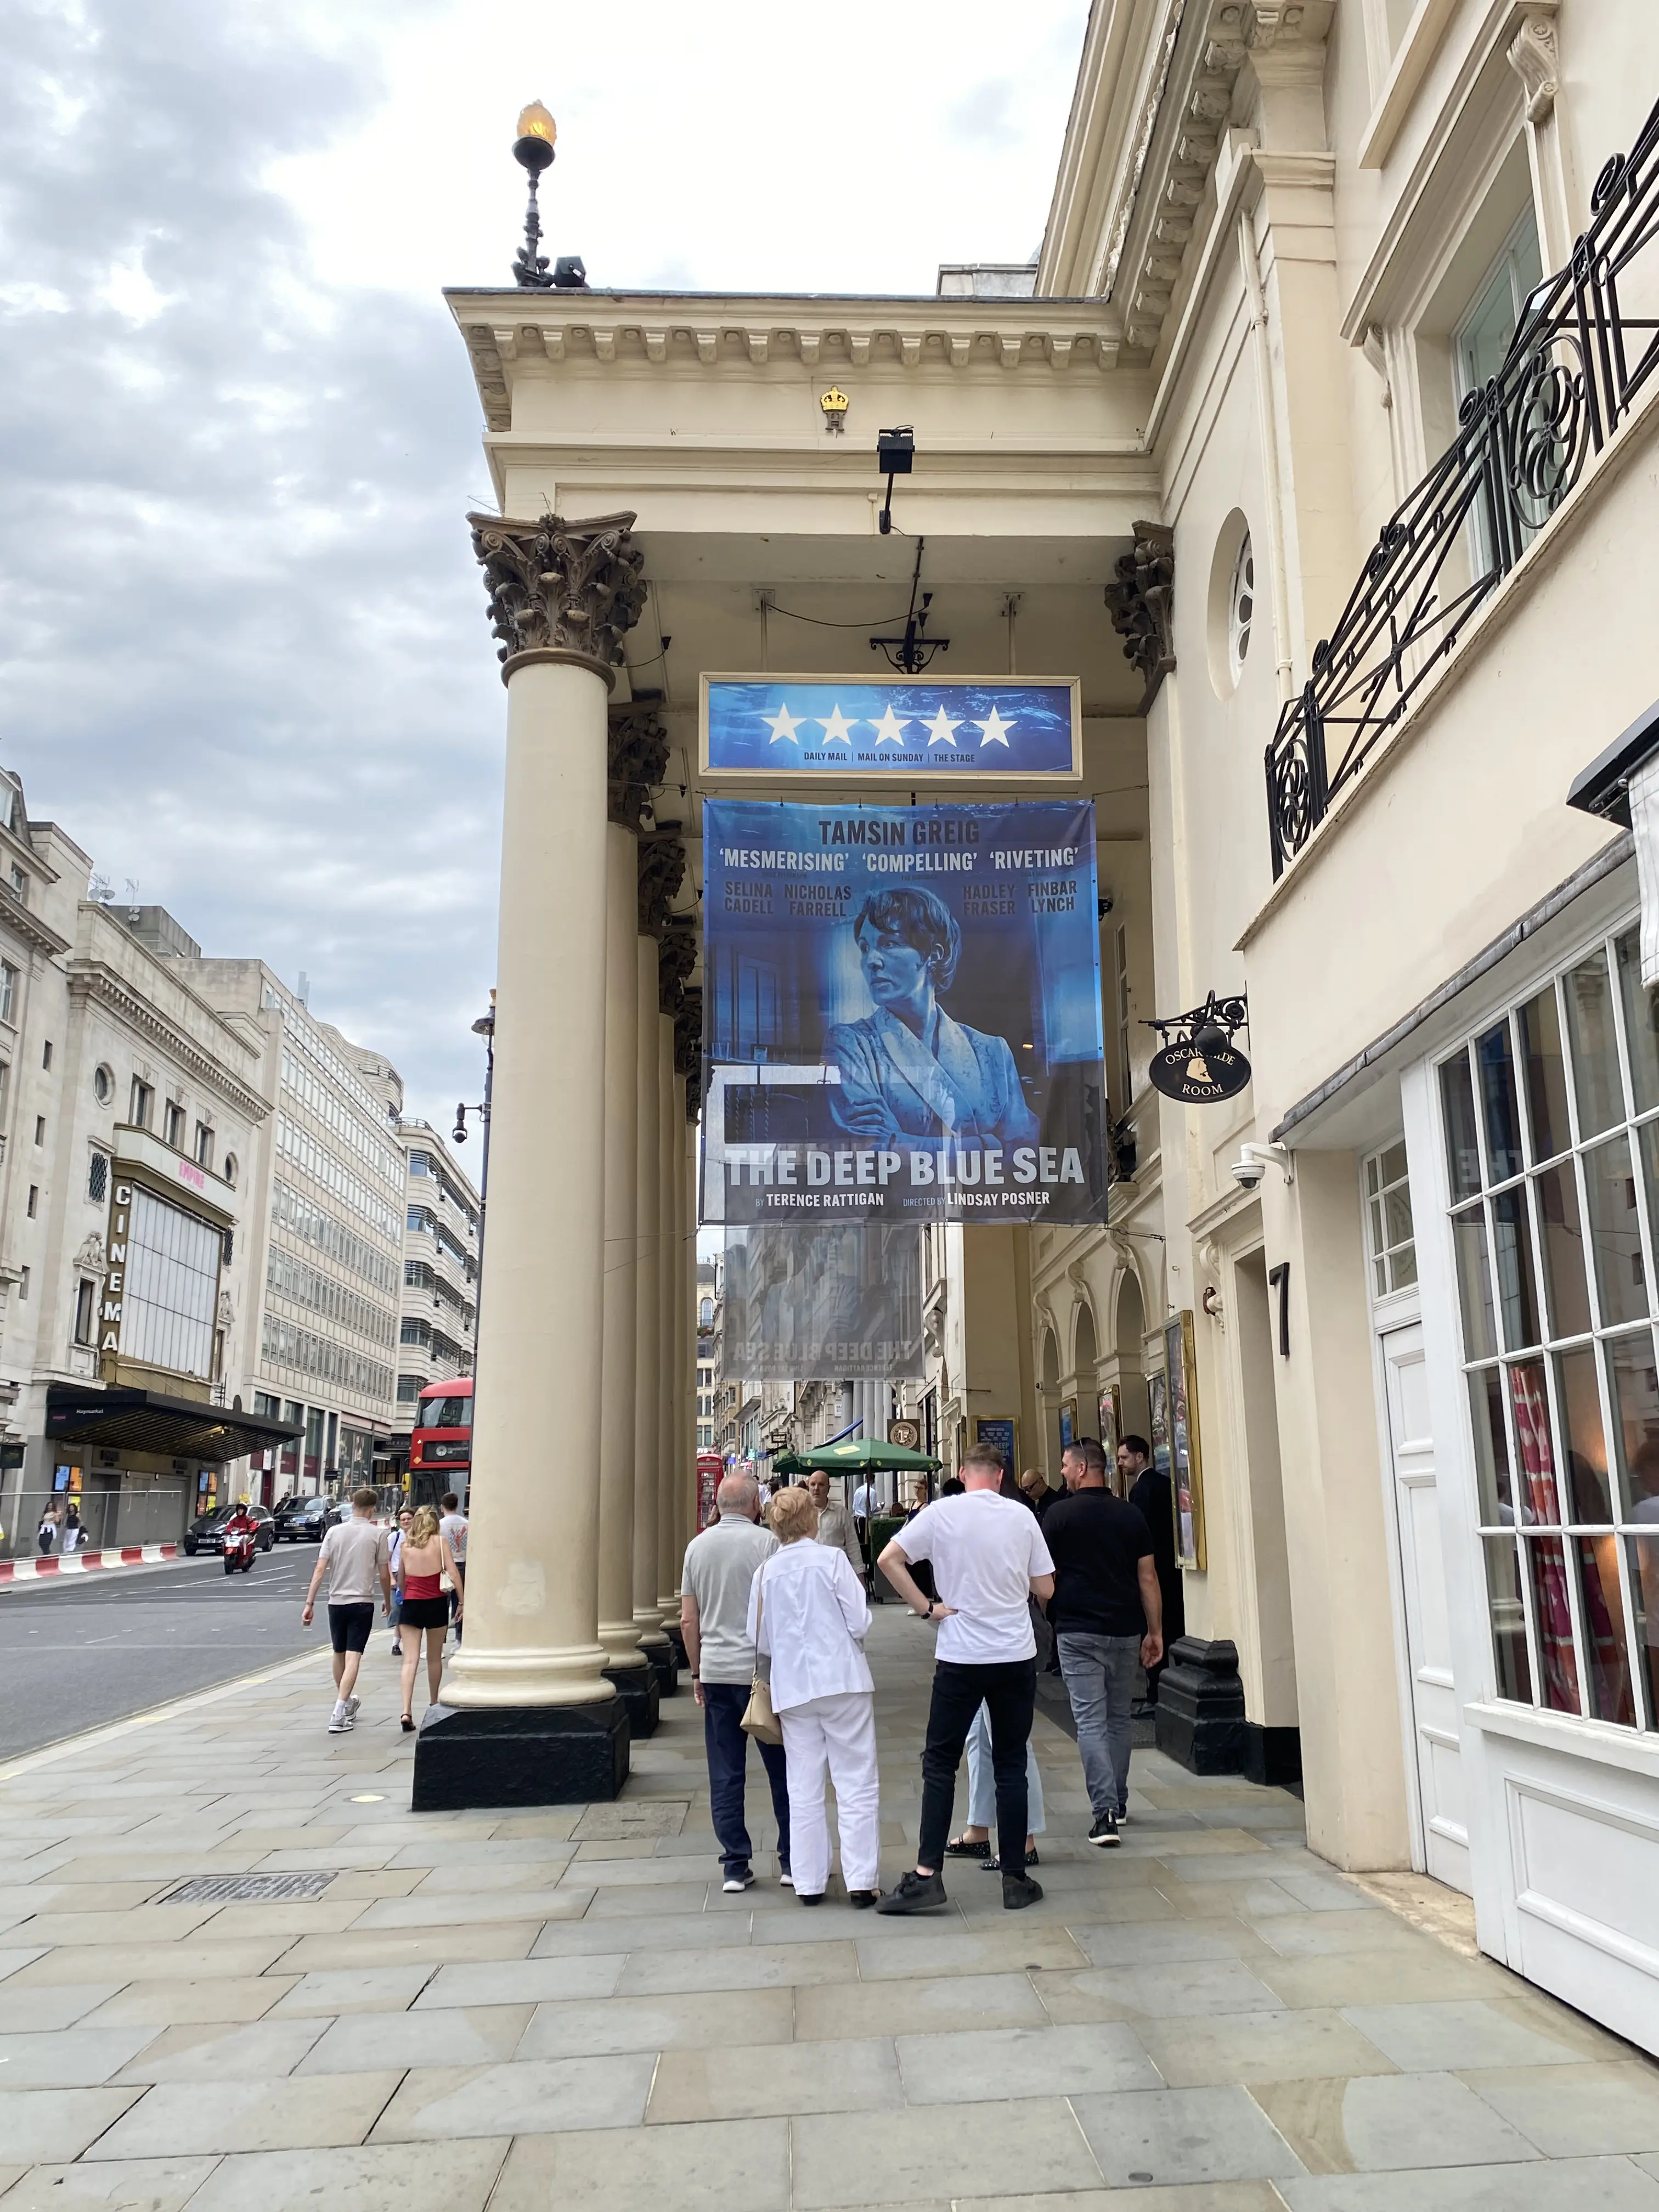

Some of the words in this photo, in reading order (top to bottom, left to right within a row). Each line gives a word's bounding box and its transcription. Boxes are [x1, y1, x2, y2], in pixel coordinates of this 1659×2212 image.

[804, 752, 826, 760] DAILY
[828, 752, 848, 761] MAIL
[857, 753, 877, 761] MAIL
[879, 753, 890, 761] ON
[892, 753, 923, 762] SUNDAY
[934, 754, 949, 762] THE
[950, 754, 975, 763] STAGE
[818, 820, 905, 846] TAMSIN
[912, 819, 979, 845] GREIG
[725, 881, 772, 898] SELINA
[784, 883, 851, 901] NICHOLAS
[963, 884, 1015, 900] HADLEY
[1028, 879, 1077, 898] FINBAR
[724, 897, 774, 915] CADELL
[789, 901, 847, 917] FARRELL
[963, 900, 1015, 916] FRASER
[1031, 896, 1074, 913] LYNCH
[1181, 1084, 1224, 1096] ROOM
[178, 1160, 205, 1189] EMPIRE
[725, 1149, 797, 1186] THE
[806, 1150, 901, 1186] DEEP
[910, 1149, 1005, 1186] BLUE
[1013, 1147, 1085, 1184] SEA
[755, 1198, 764, 1207] BY
[766, 1194, 820, 1207] TERENCE
[823, 1193, 884, 1207] RATTIGAN
[903, 1197, 935, 1207] DIRECTED
[936, 1196, 945, 1205] BY
[947, 1192, 999, 1206] LINDSAY
[1002, 1192, 1050, 1205] POSNER
[101, 1186, 131, 1352] CINEMA
